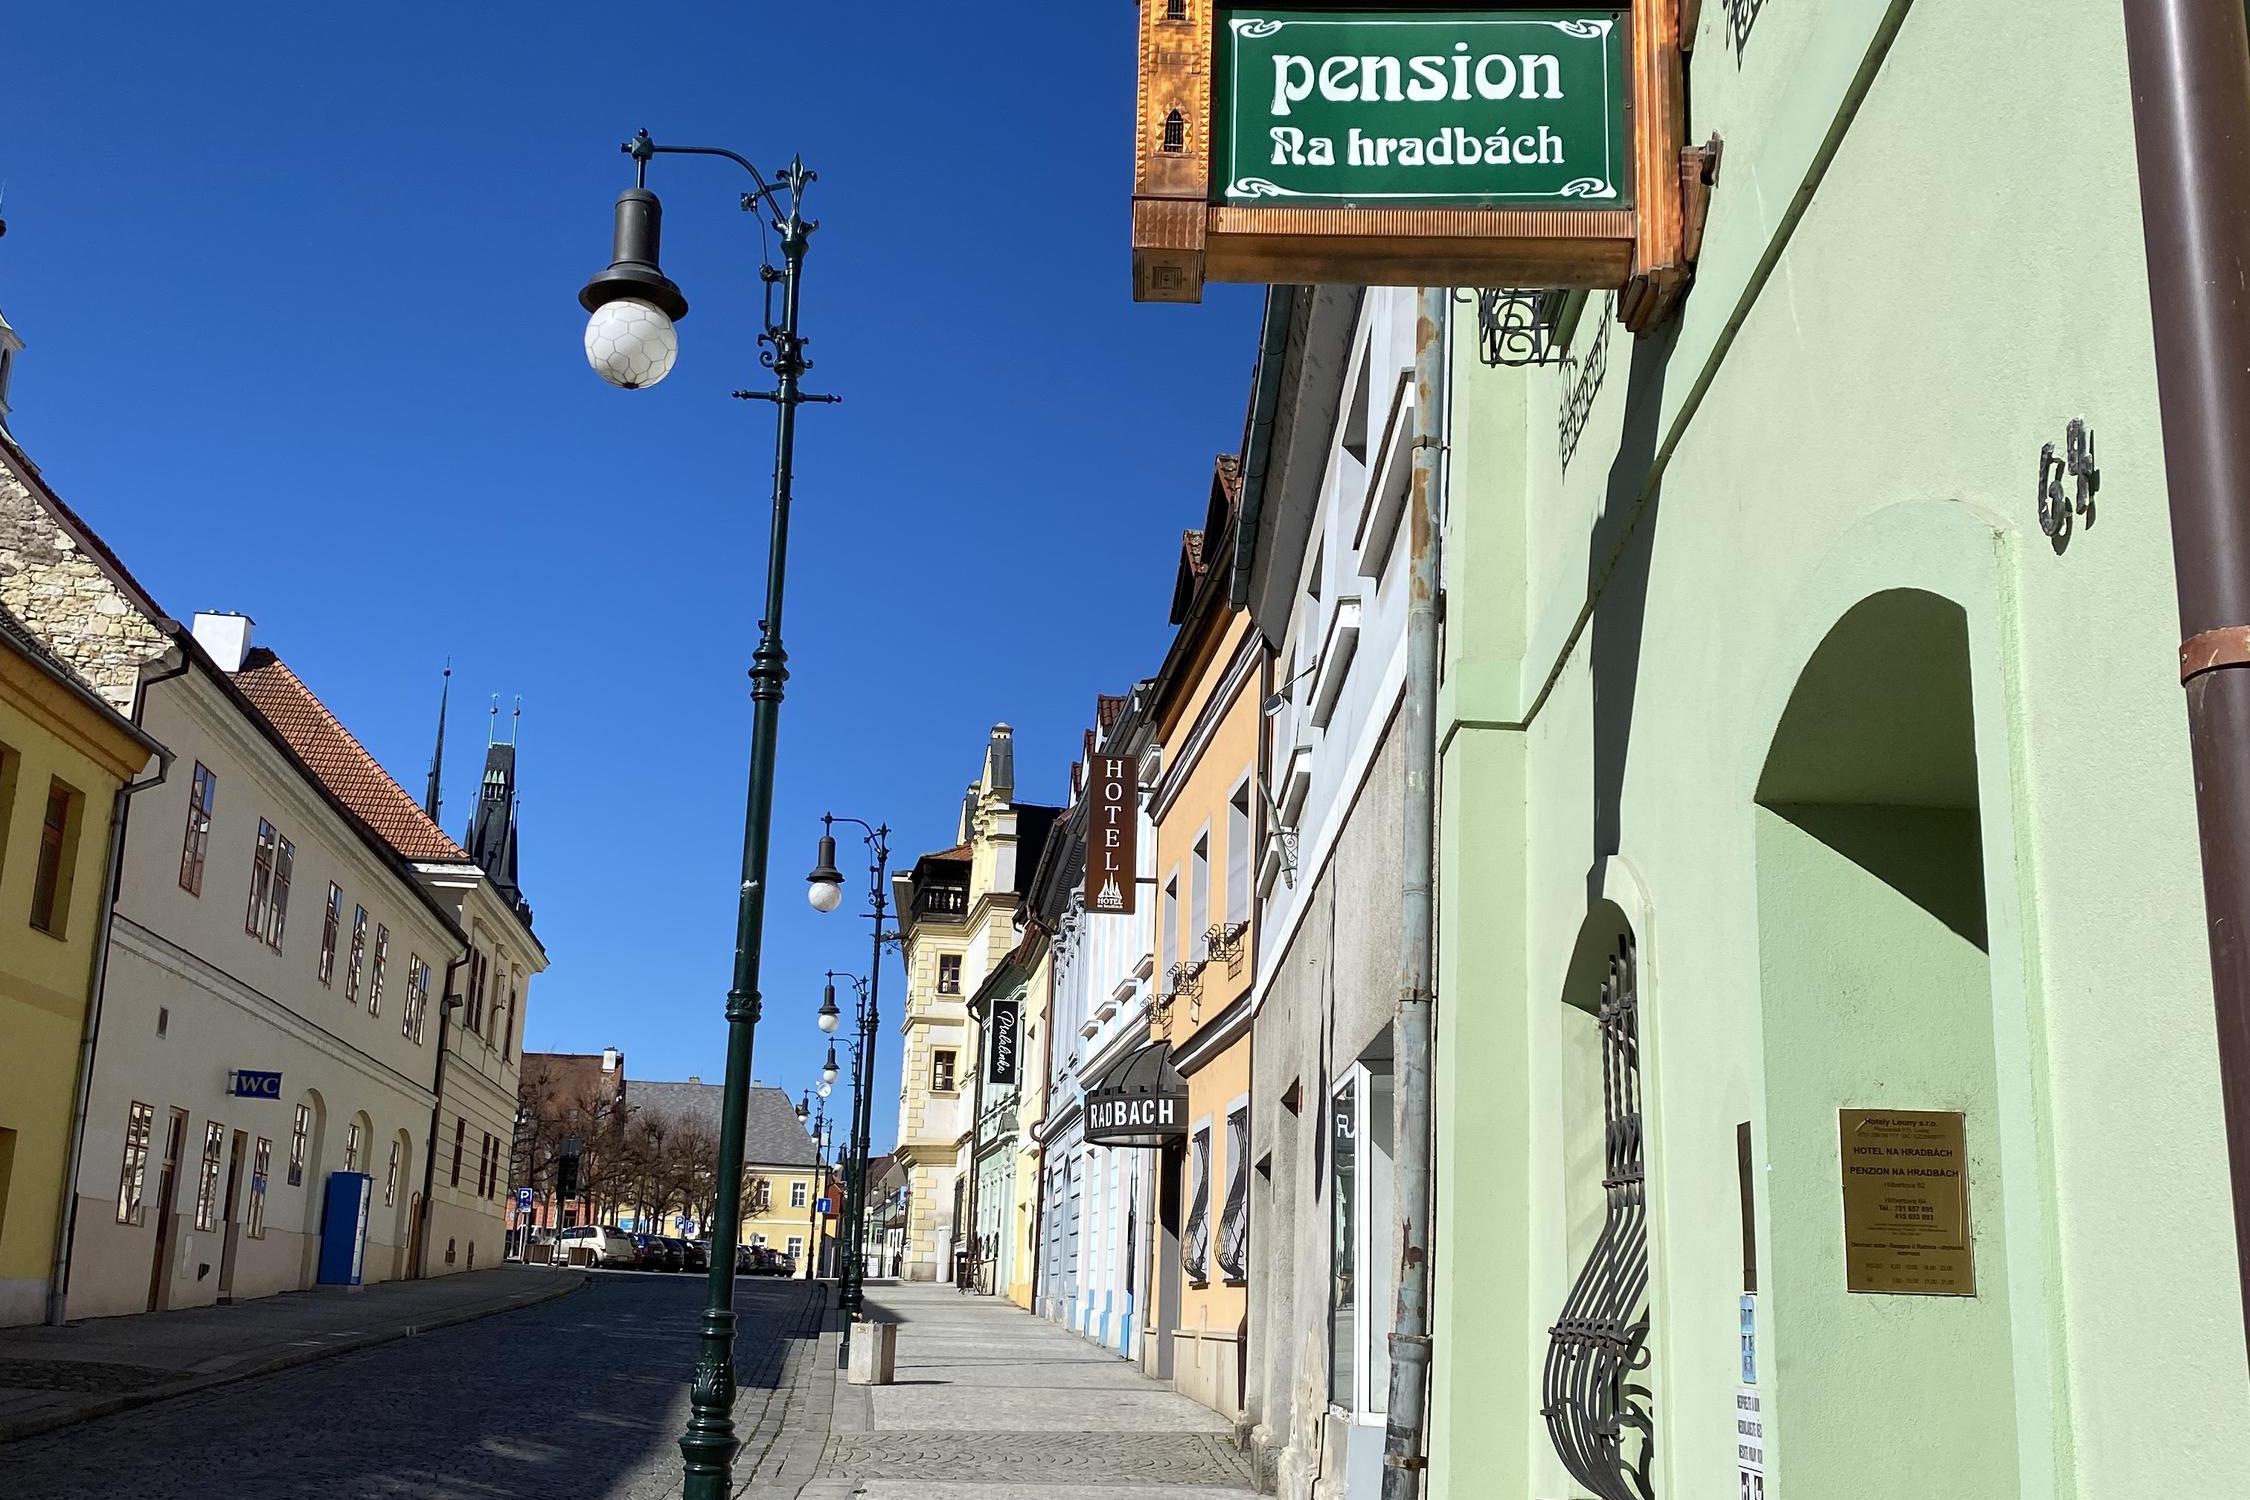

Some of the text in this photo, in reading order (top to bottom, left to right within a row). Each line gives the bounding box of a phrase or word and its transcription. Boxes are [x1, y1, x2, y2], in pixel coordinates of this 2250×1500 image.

[1270, 42, 1564, 115] pension
[1270, 126, 1565, 166] Na hradbách
[2038, 417, 2093, 537] 64
[1104, 759, 1123, 871] HOTEL
[1097, 897, 1123, 905] HOTEL
[240, 1075, 279, 1094] WC
[1892, 1119, 1917, 1128] Louny
[1853, 1147, 1953, 1157] HOTEL NA HRADBÁCH
[1849, 1166, 1959, 1178] PENZION NA HRADBÁCH
[521, 1191, 529, 1200] P
[677, 1217, 683, 1225] P
